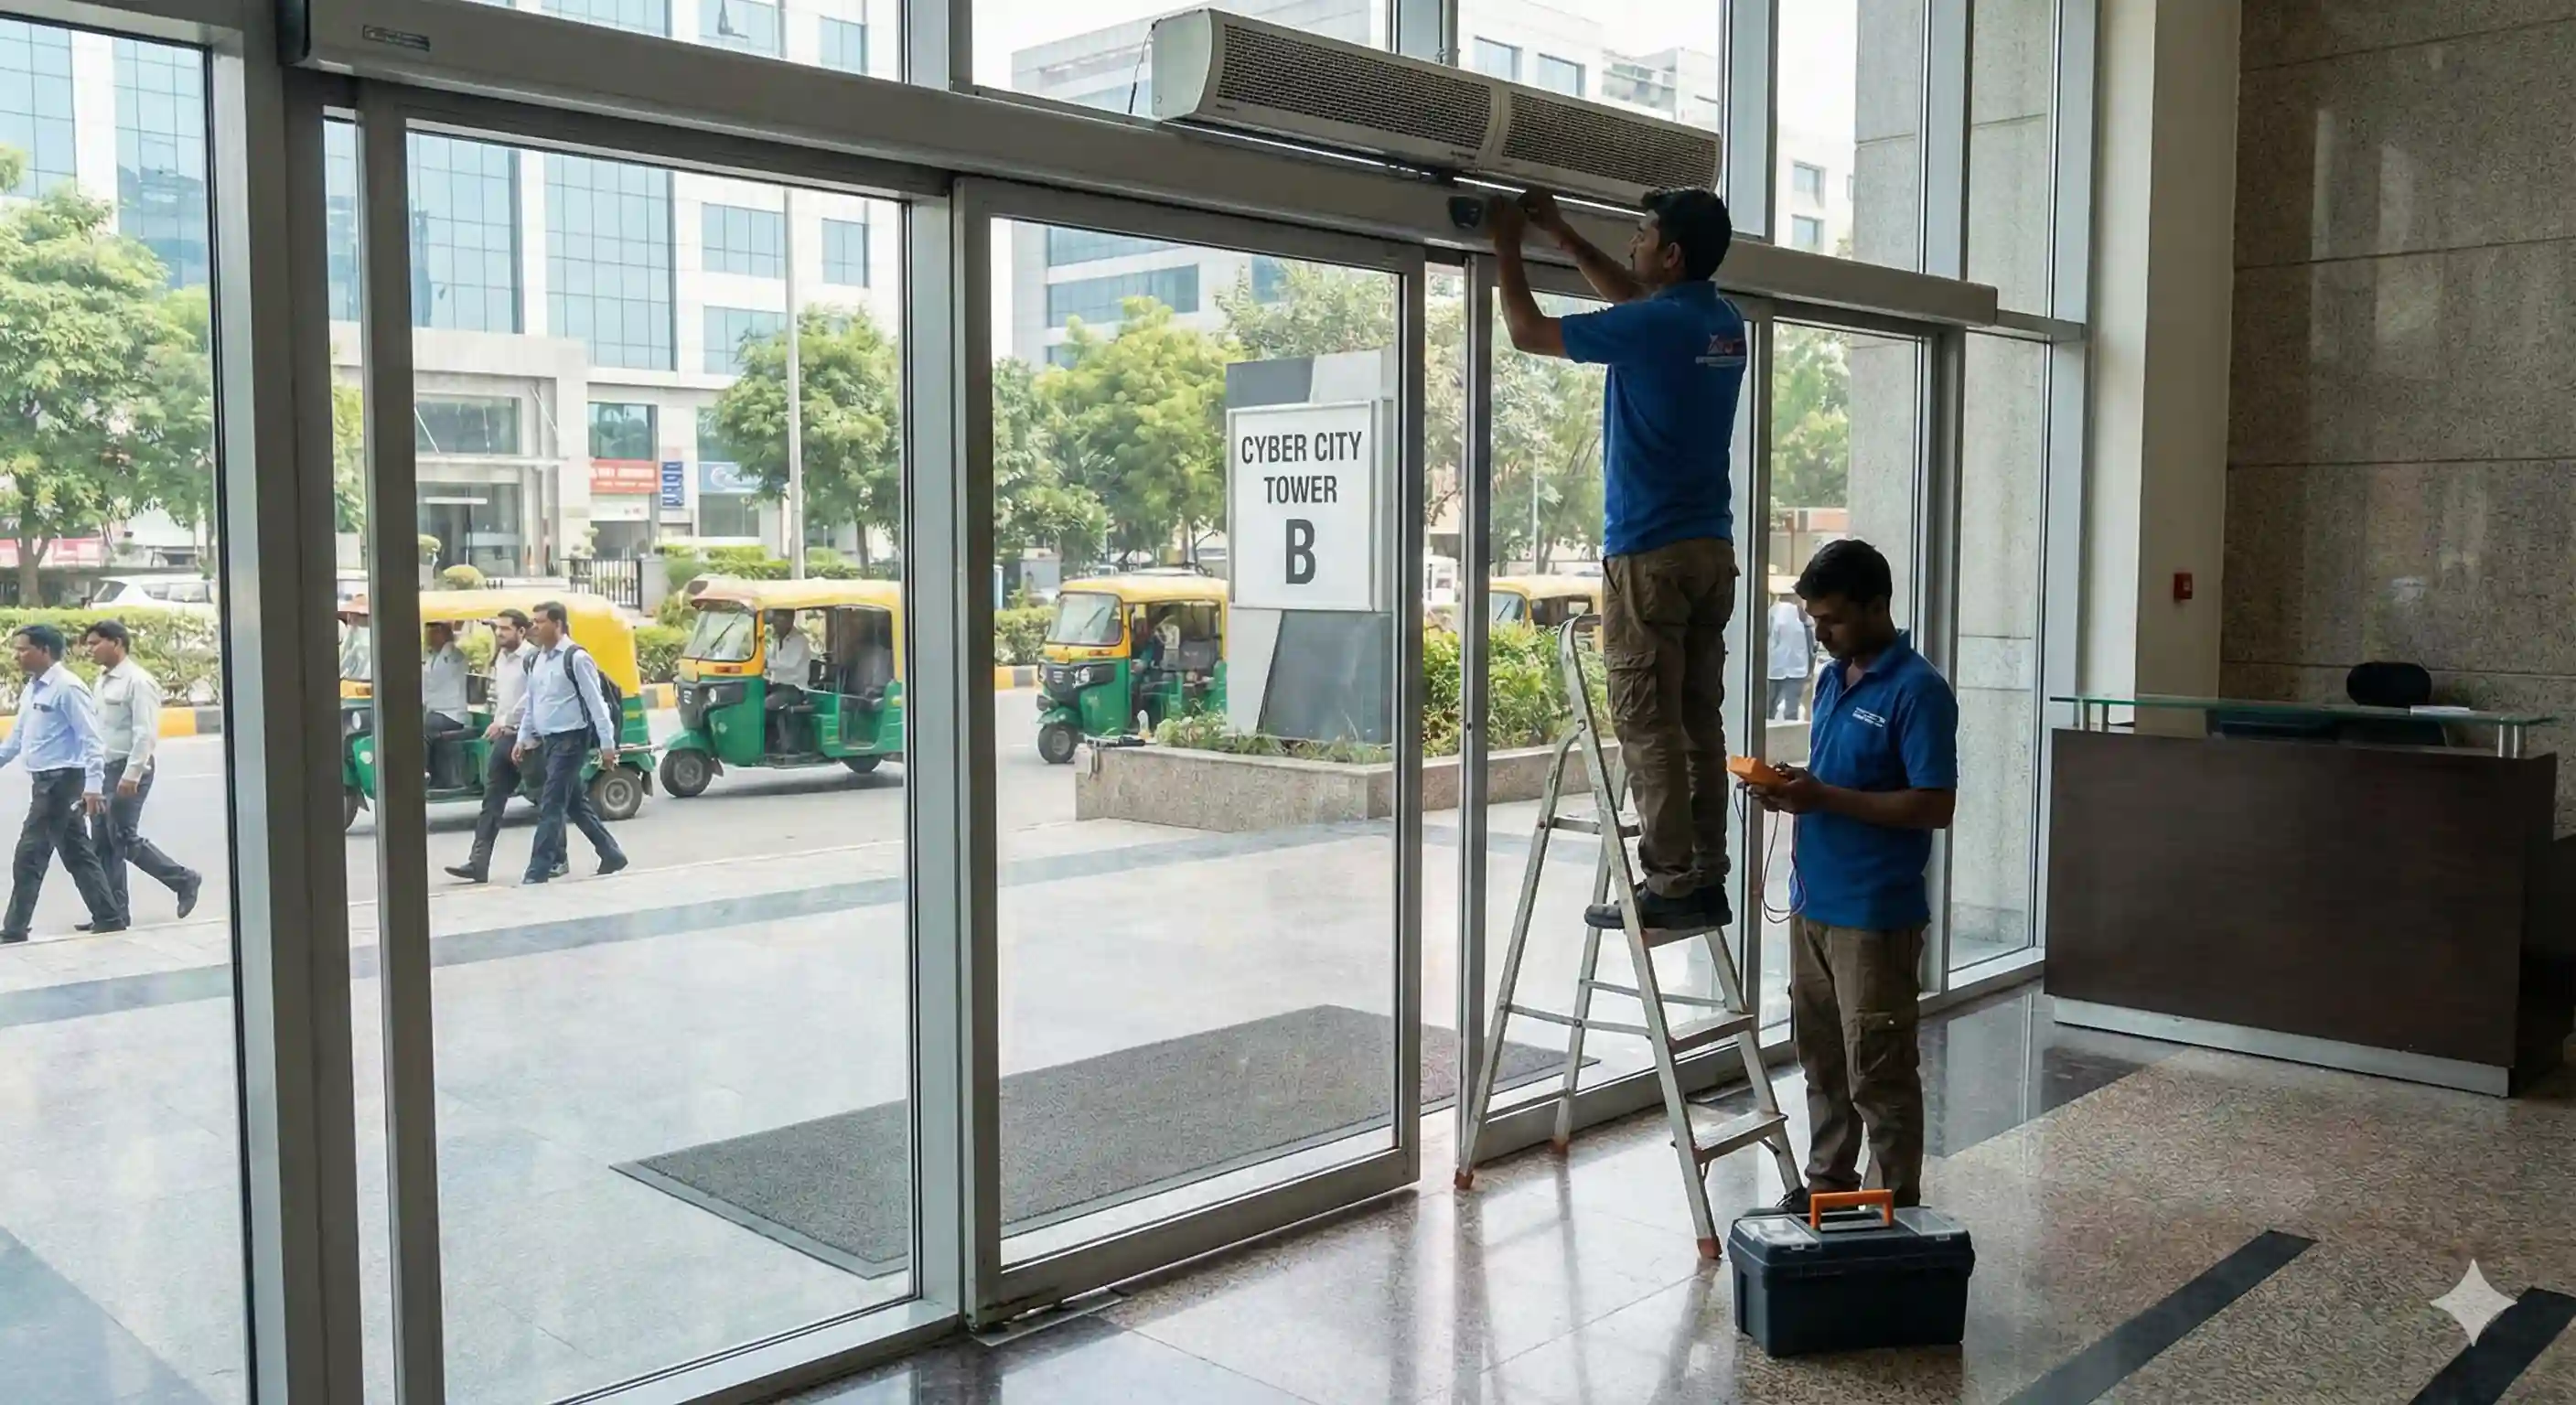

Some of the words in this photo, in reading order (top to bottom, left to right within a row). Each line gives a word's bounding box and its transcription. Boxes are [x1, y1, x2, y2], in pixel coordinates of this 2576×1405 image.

[1241, 434, 1307, 464] CYBER
[1315, 431, 1362, 462] CITY
[1263, 475, 1337, 504] TOWER
[1285, 519, 1316, 585] B
